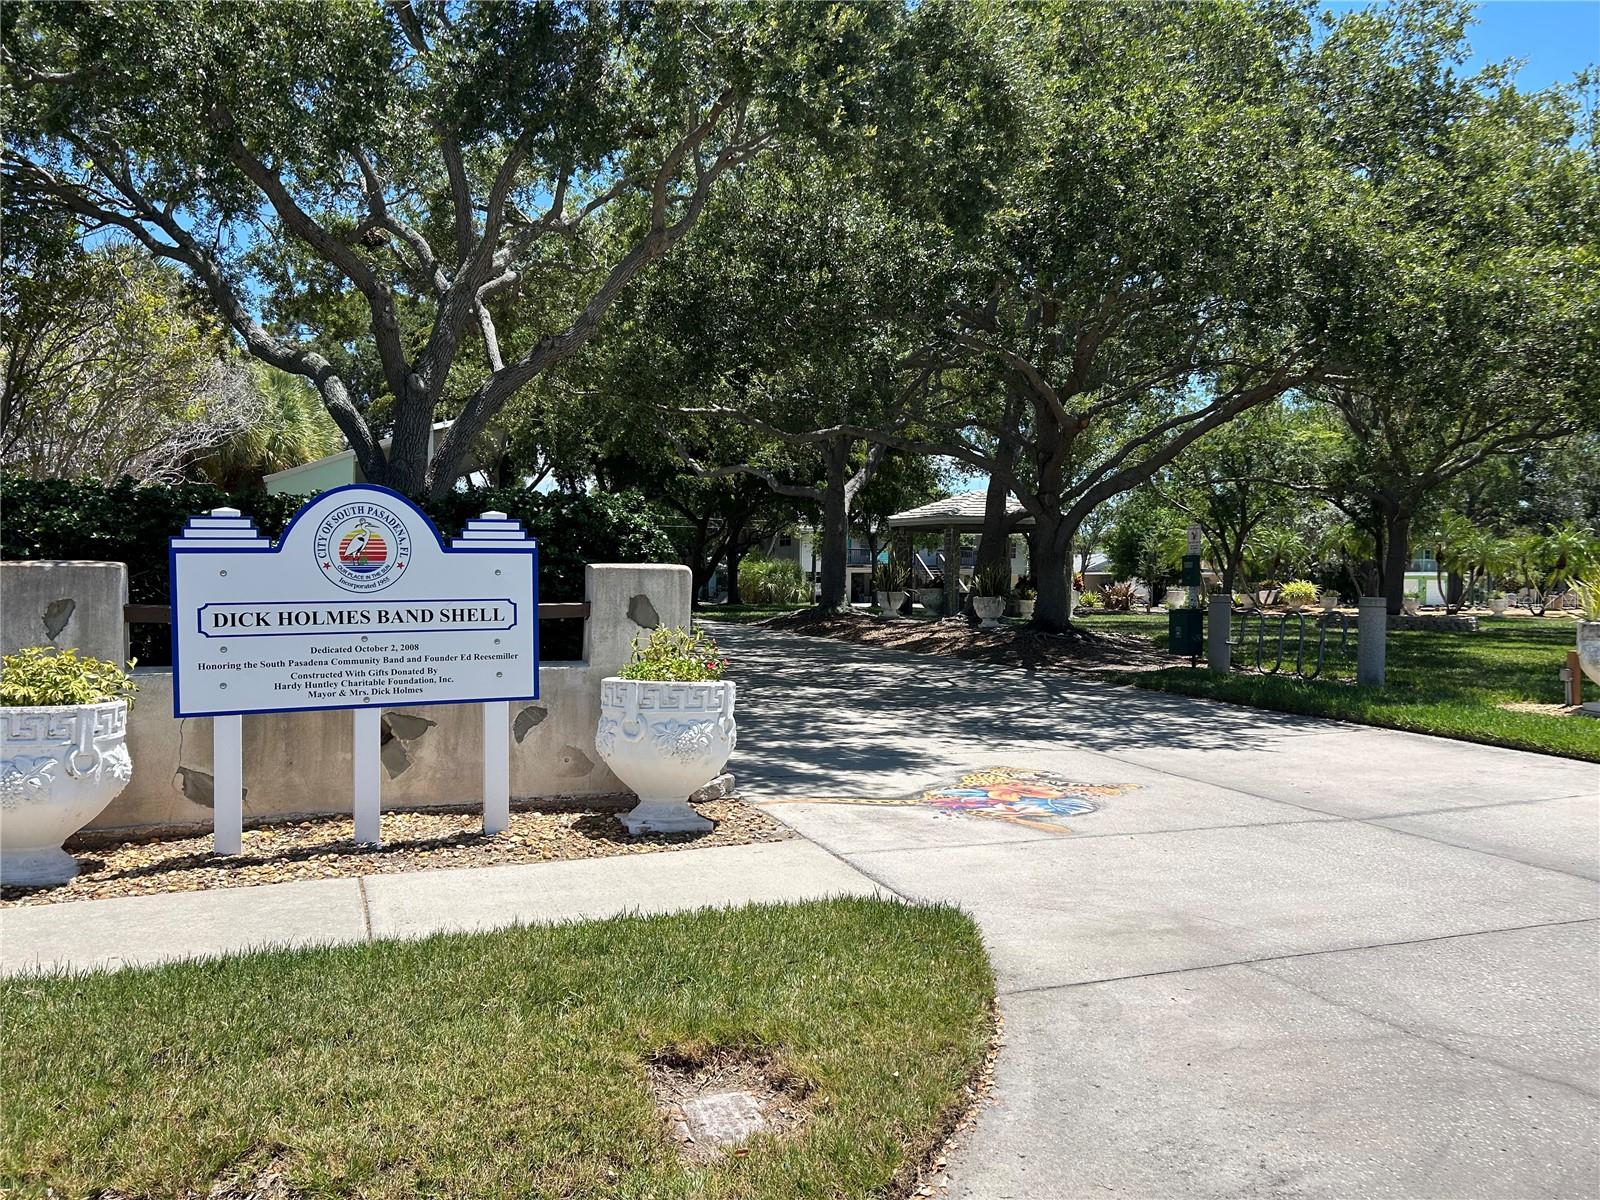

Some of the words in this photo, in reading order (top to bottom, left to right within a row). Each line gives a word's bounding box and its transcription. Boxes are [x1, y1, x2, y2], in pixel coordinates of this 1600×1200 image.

[317, 535, 327, 558] CITY
[322, 521, 334, 534] OF
[332, 506, 364, 523] SOUTH
[367, 506, 406, 545] PASADENA,
[400, 547, 408, 558] FL
[337, 565, 348, 576] OUR
[382, 564, 390, 573] SUN
[339, 578, 376, 589] Incorporated
[213, 612, 272, 628] DICK
[278, 610, 371, 625] HOLMES
[377, 609, 434, 624] BAND
[440, 608, 505, 622] SHELL
[310, 646, 352, 654] Dedicated
[355, 645, 388, 653] October
[198, 662, 241, 671] Honoring
[244, 661, 258, 669] the
[260, 660, 285, 668] South
[288, 659, 329, 667] Pasadena
[331, 655, 380, 665] Community
[474, 653, 518, 661] Reesemiller
[290, 671, 343, 680] Constructed
[345, 669, 366, 677] With
[427, 668, 437, 676] By
[274, 682, 301, 691] Hardy
[305, 681, 338, 690] Huntley
[341, 677, 385, 687] Charitable
[388, 677, 436, 685] Foundation,
[308, 690, 336, 699] Mayor
[349, 688, 369, 696] Mrs.
[371, 687, 391, 695] Dick
